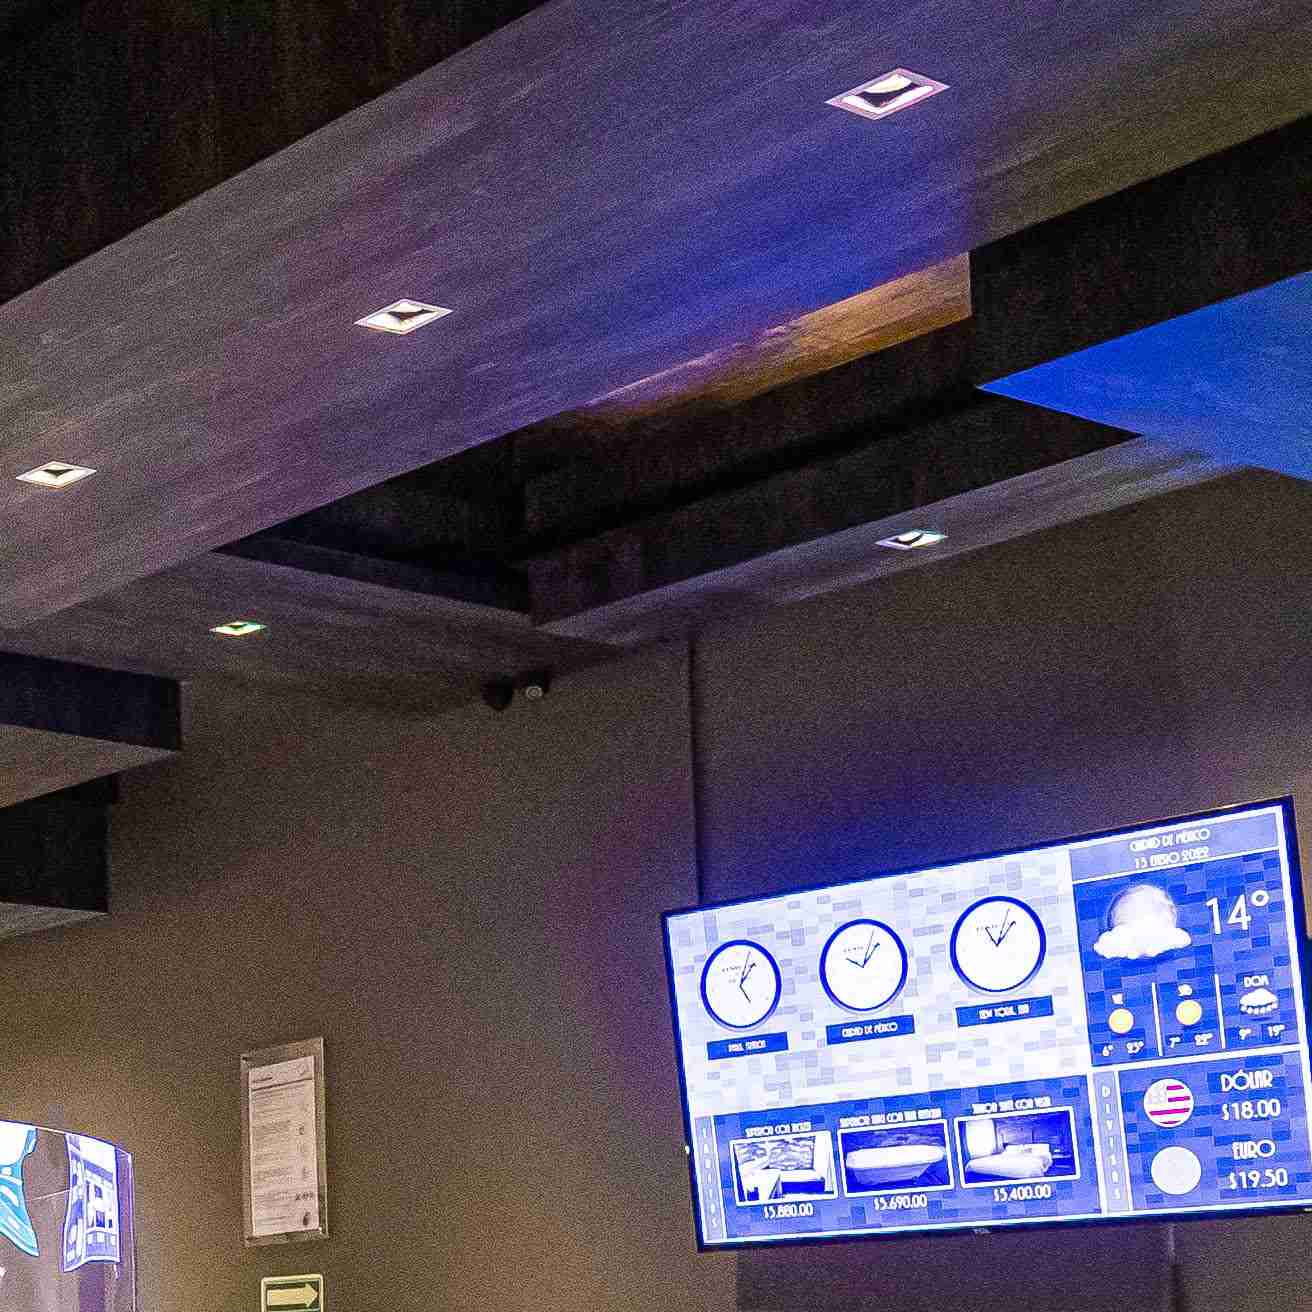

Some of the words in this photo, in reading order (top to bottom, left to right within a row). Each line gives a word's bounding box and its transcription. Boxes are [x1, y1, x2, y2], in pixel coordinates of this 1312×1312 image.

[1221, 1098, 1282, 1121] $18.00
[1232, 1138, 1277, 1161] EURO
[1229, 1167, 1289, 1190] $19.50
